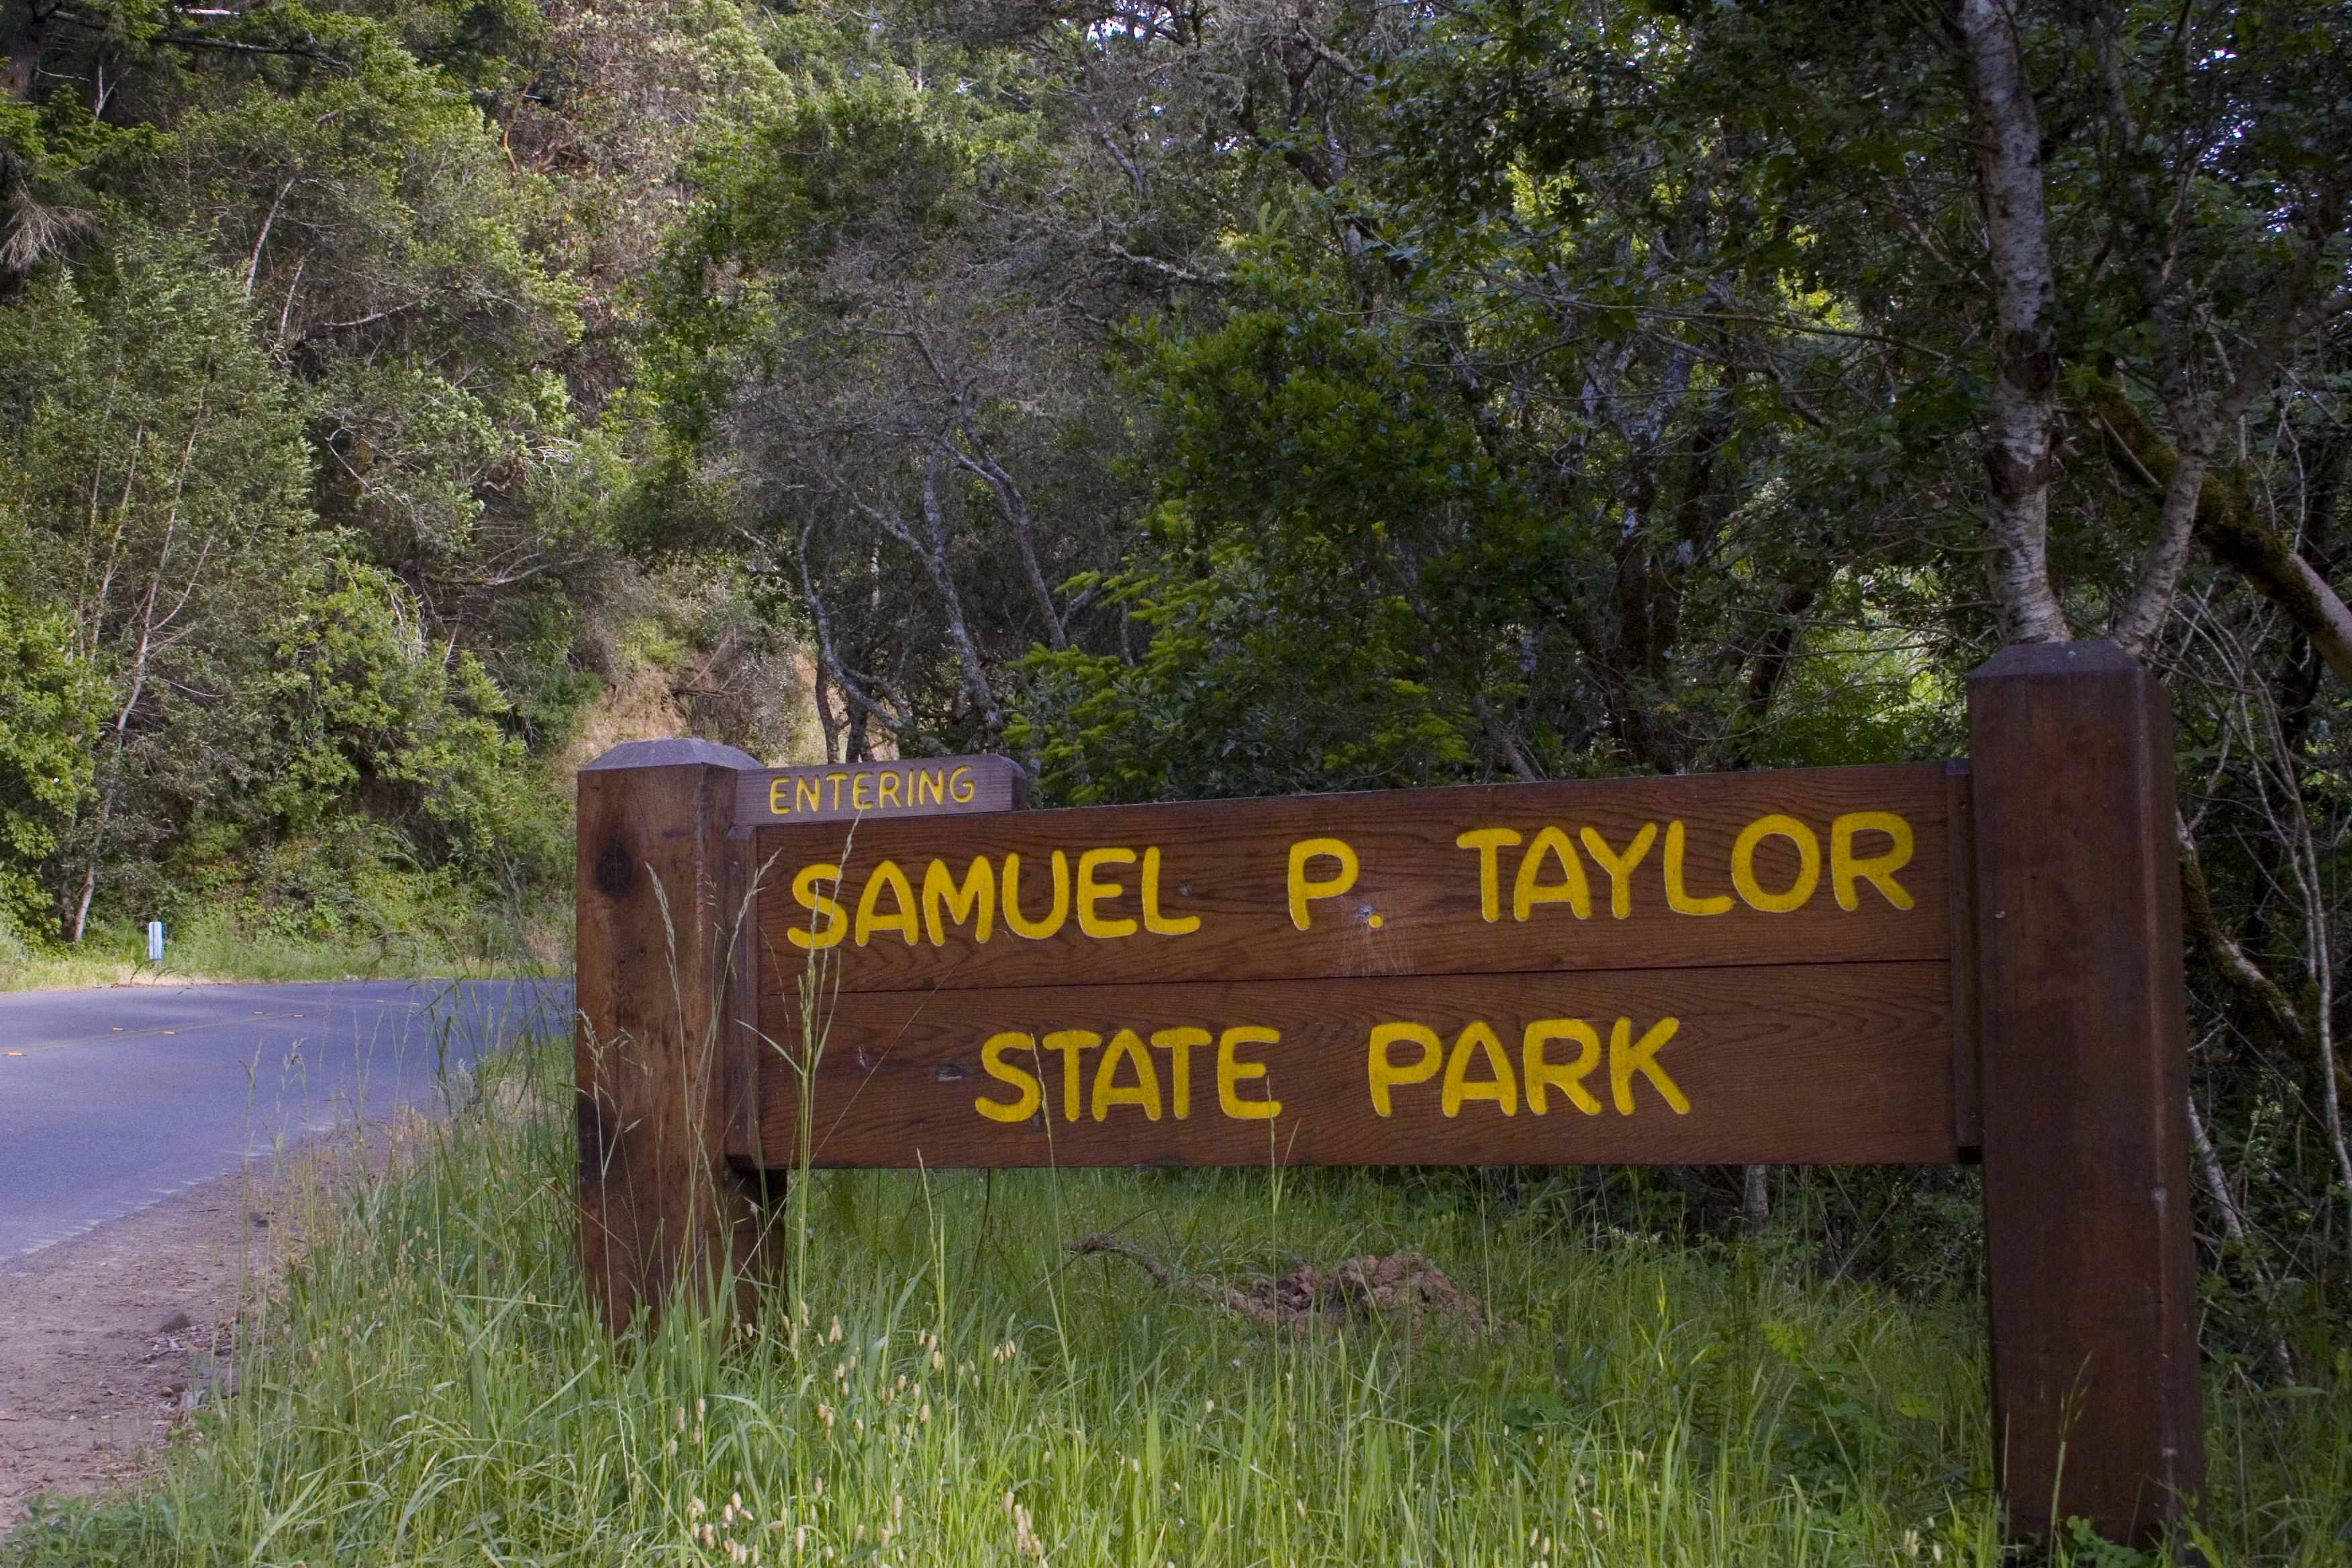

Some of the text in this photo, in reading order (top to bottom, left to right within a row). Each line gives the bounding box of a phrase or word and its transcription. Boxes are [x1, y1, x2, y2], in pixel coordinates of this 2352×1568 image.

[769, 765, 975, 814] ENTERING
[787, 811, 1916, 948] SAMUEL P. TAYLOR
[975, 1016, 1692, 1122] STATE PARK
